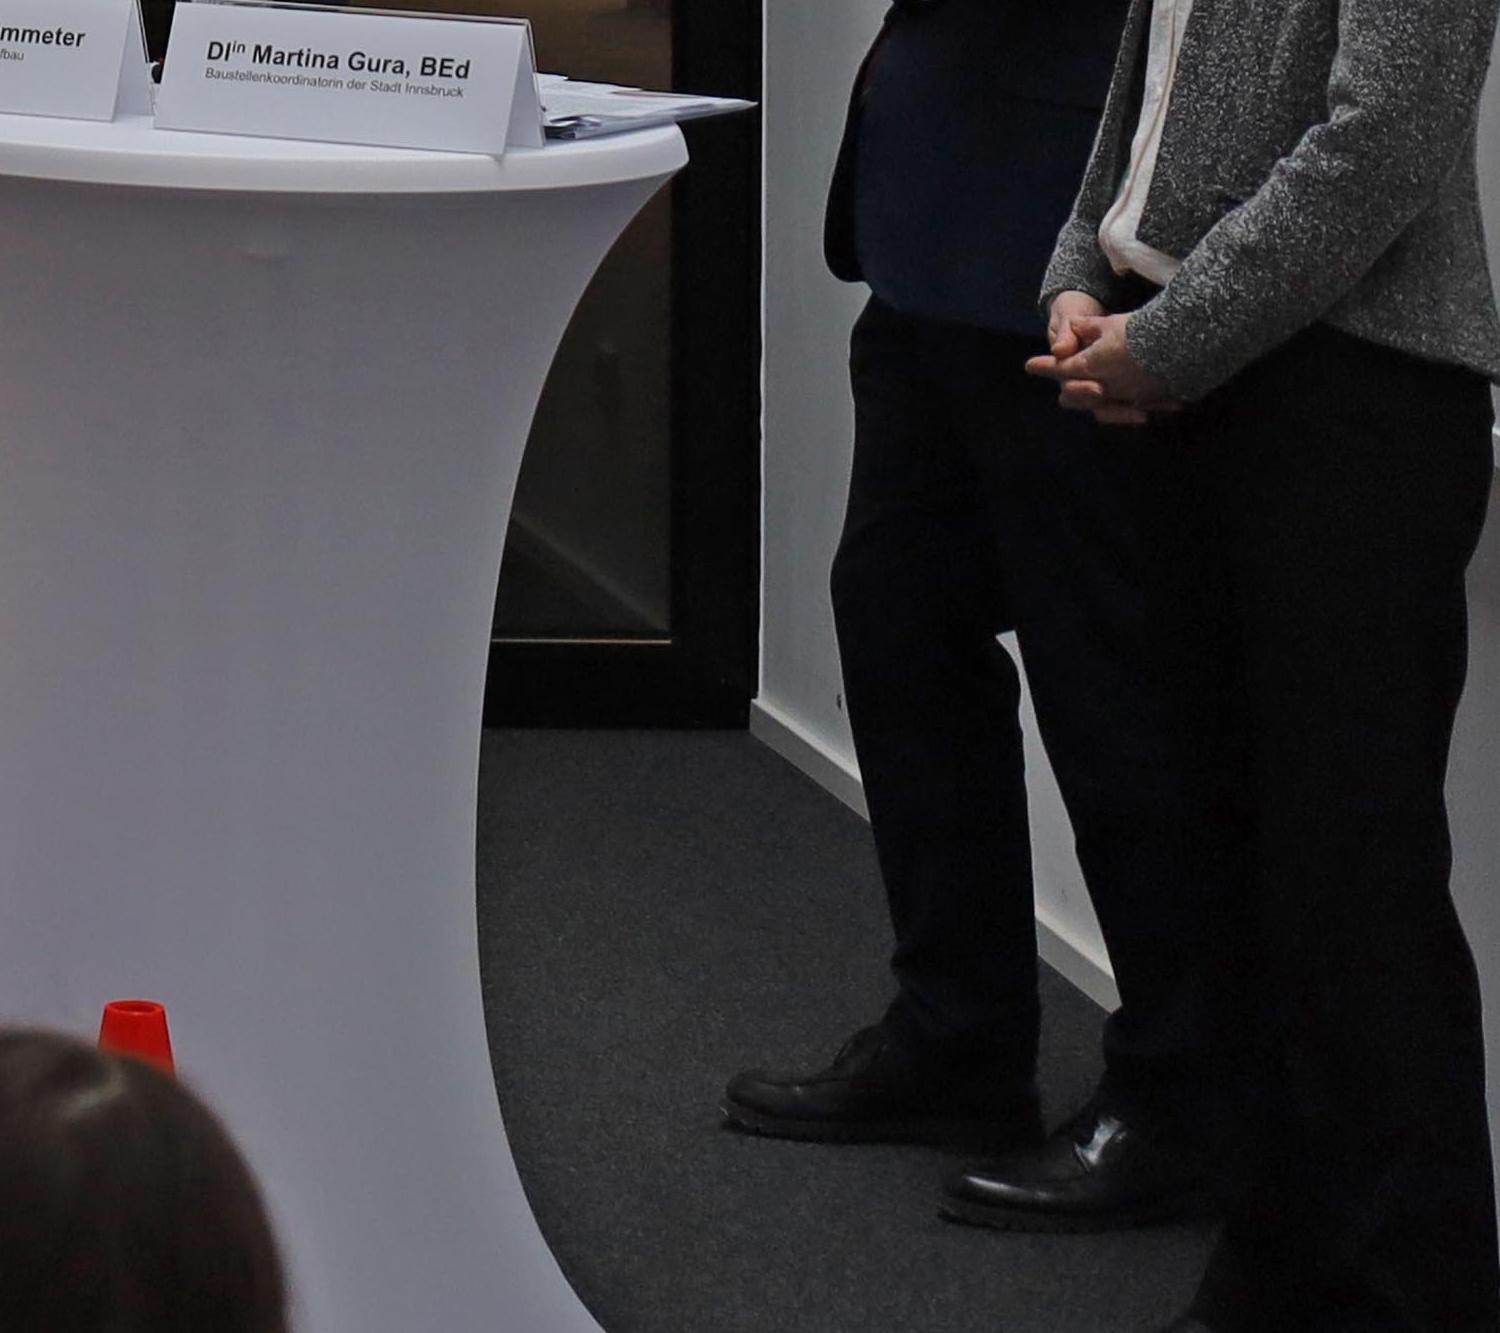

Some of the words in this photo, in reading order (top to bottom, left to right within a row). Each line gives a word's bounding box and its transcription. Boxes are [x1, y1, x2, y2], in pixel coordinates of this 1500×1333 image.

[252, 44, 340, 70] Martina
[347, 51, 411, 77] Gura,
[419, 56, 471, 80] BEd
[205, 67, 344, 90] Baustellenkoordinatorin
[346, 77, 367, 91] der
[369, 79, 402, 94] Stadt
[405, 82, 464, 98] Innsbruck
